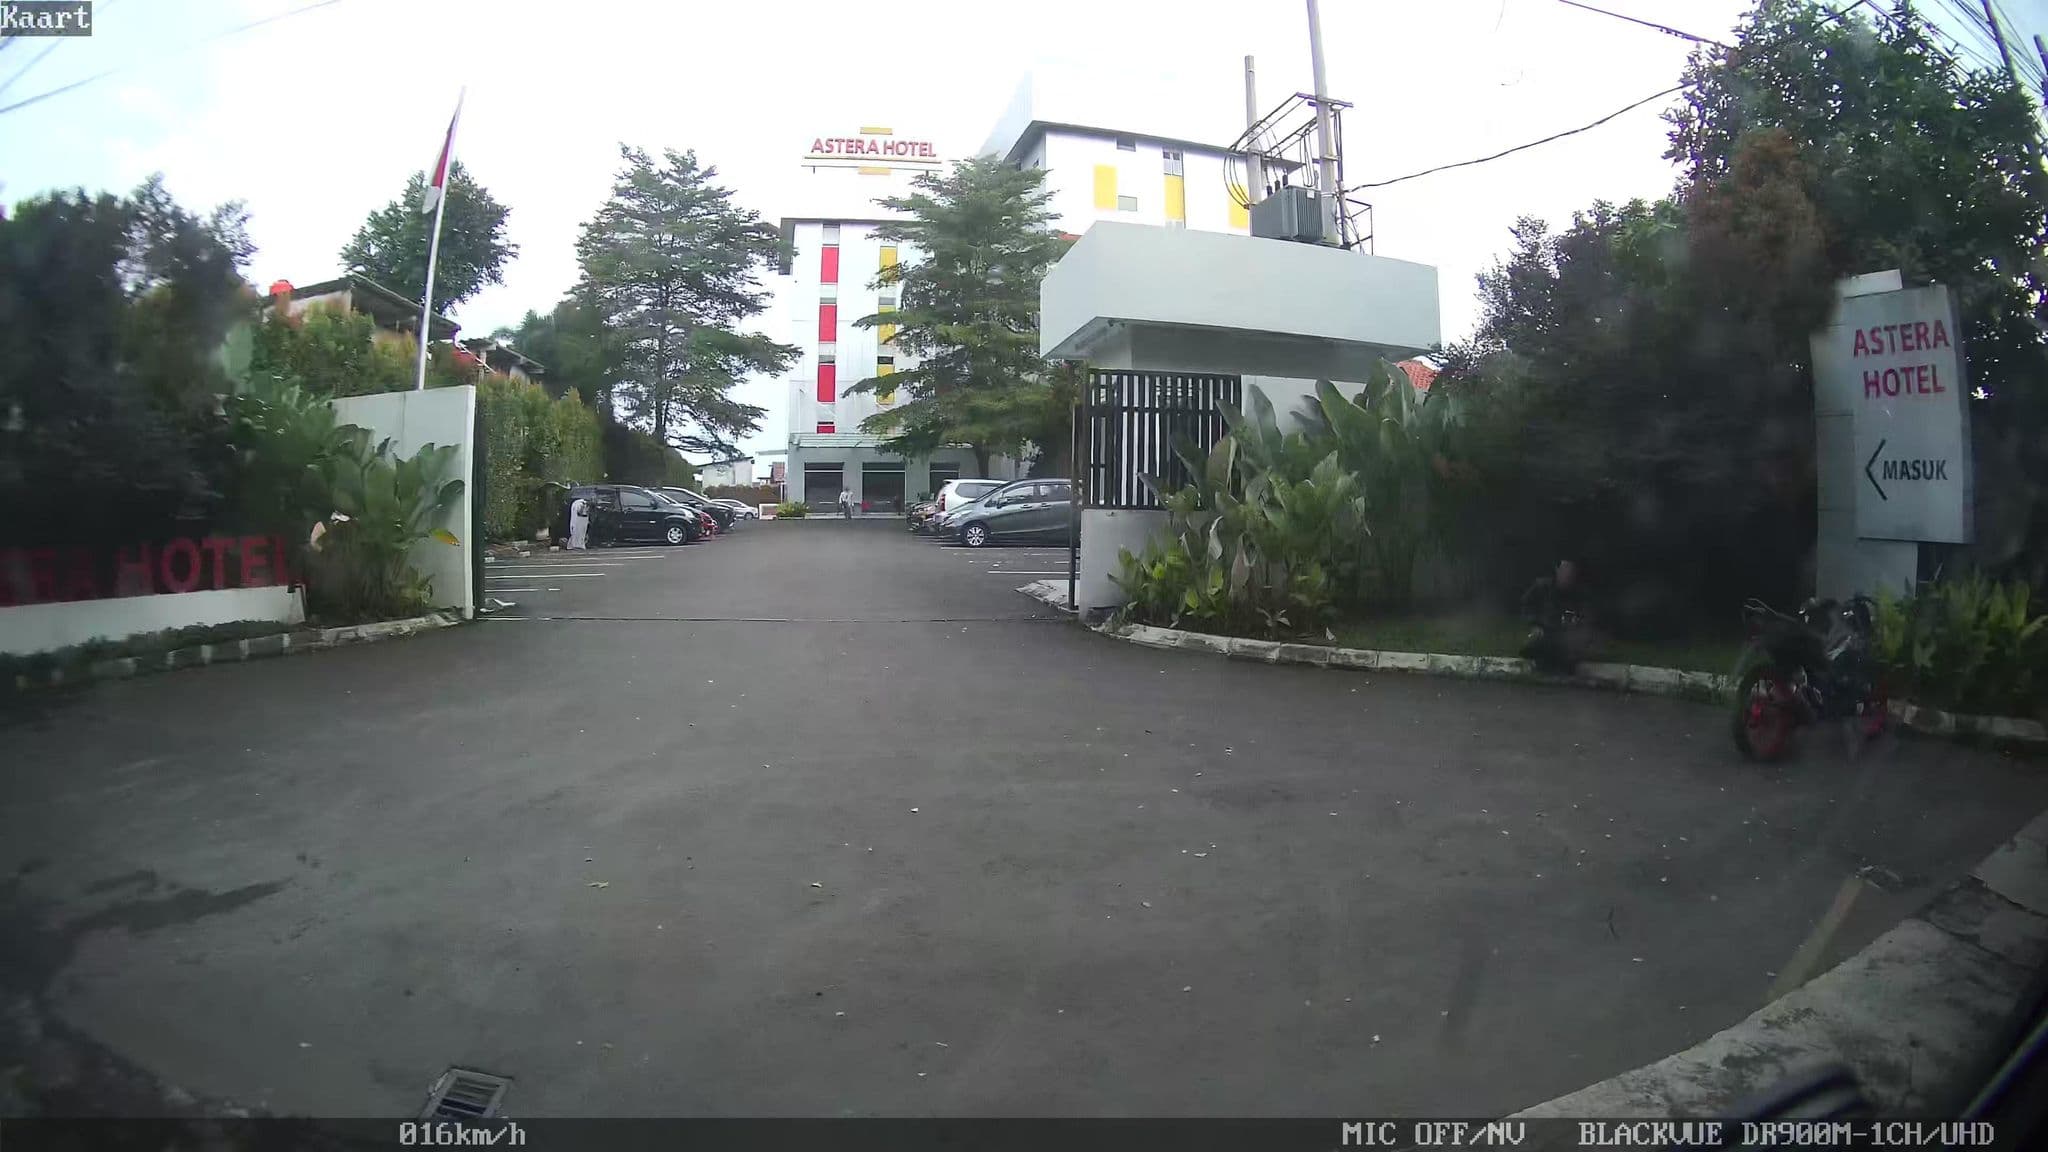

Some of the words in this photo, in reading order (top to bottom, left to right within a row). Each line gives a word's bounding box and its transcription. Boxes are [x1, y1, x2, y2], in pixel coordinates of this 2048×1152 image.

[811, 138, 879, 155] ASTERA
[883, 140, 937, 157] HOTEL
[1853, 319, 1949, 357] ASTERA
[1863, 364, 1946, 399] HOTEL
[1883, 459, 1948, 481] MASUK
[115, 535, 309, 597] HOTEL
